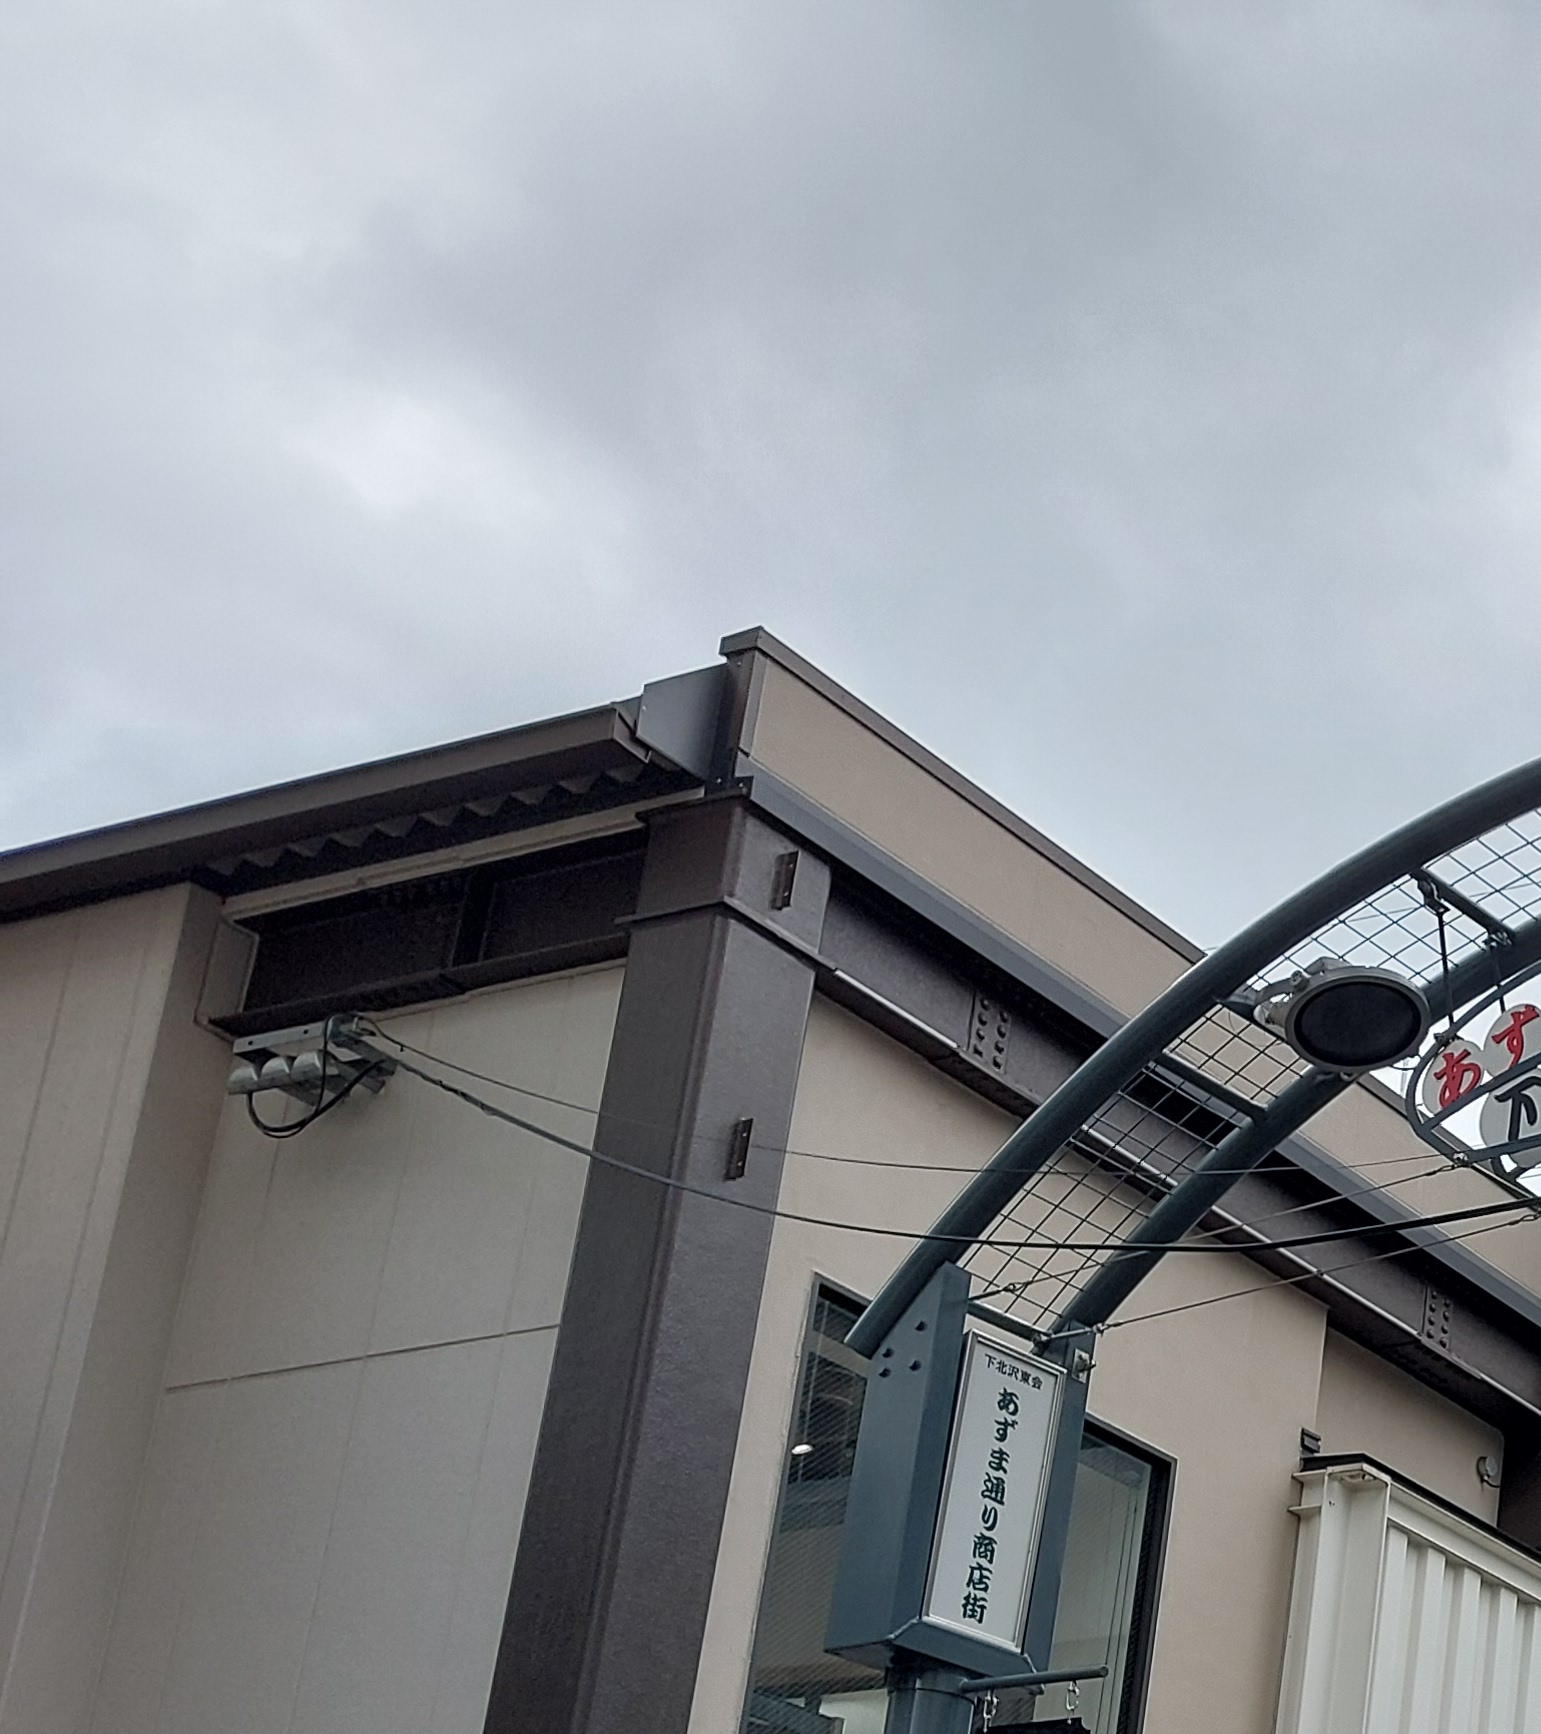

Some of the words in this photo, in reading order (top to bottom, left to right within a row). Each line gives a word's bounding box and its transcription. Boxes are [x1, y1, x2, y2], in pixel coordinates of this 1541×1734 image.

[984, 1353, 1044, 1392] 下北沢東会
[961, 1387, 1020, 1625] あずま通り商店街
